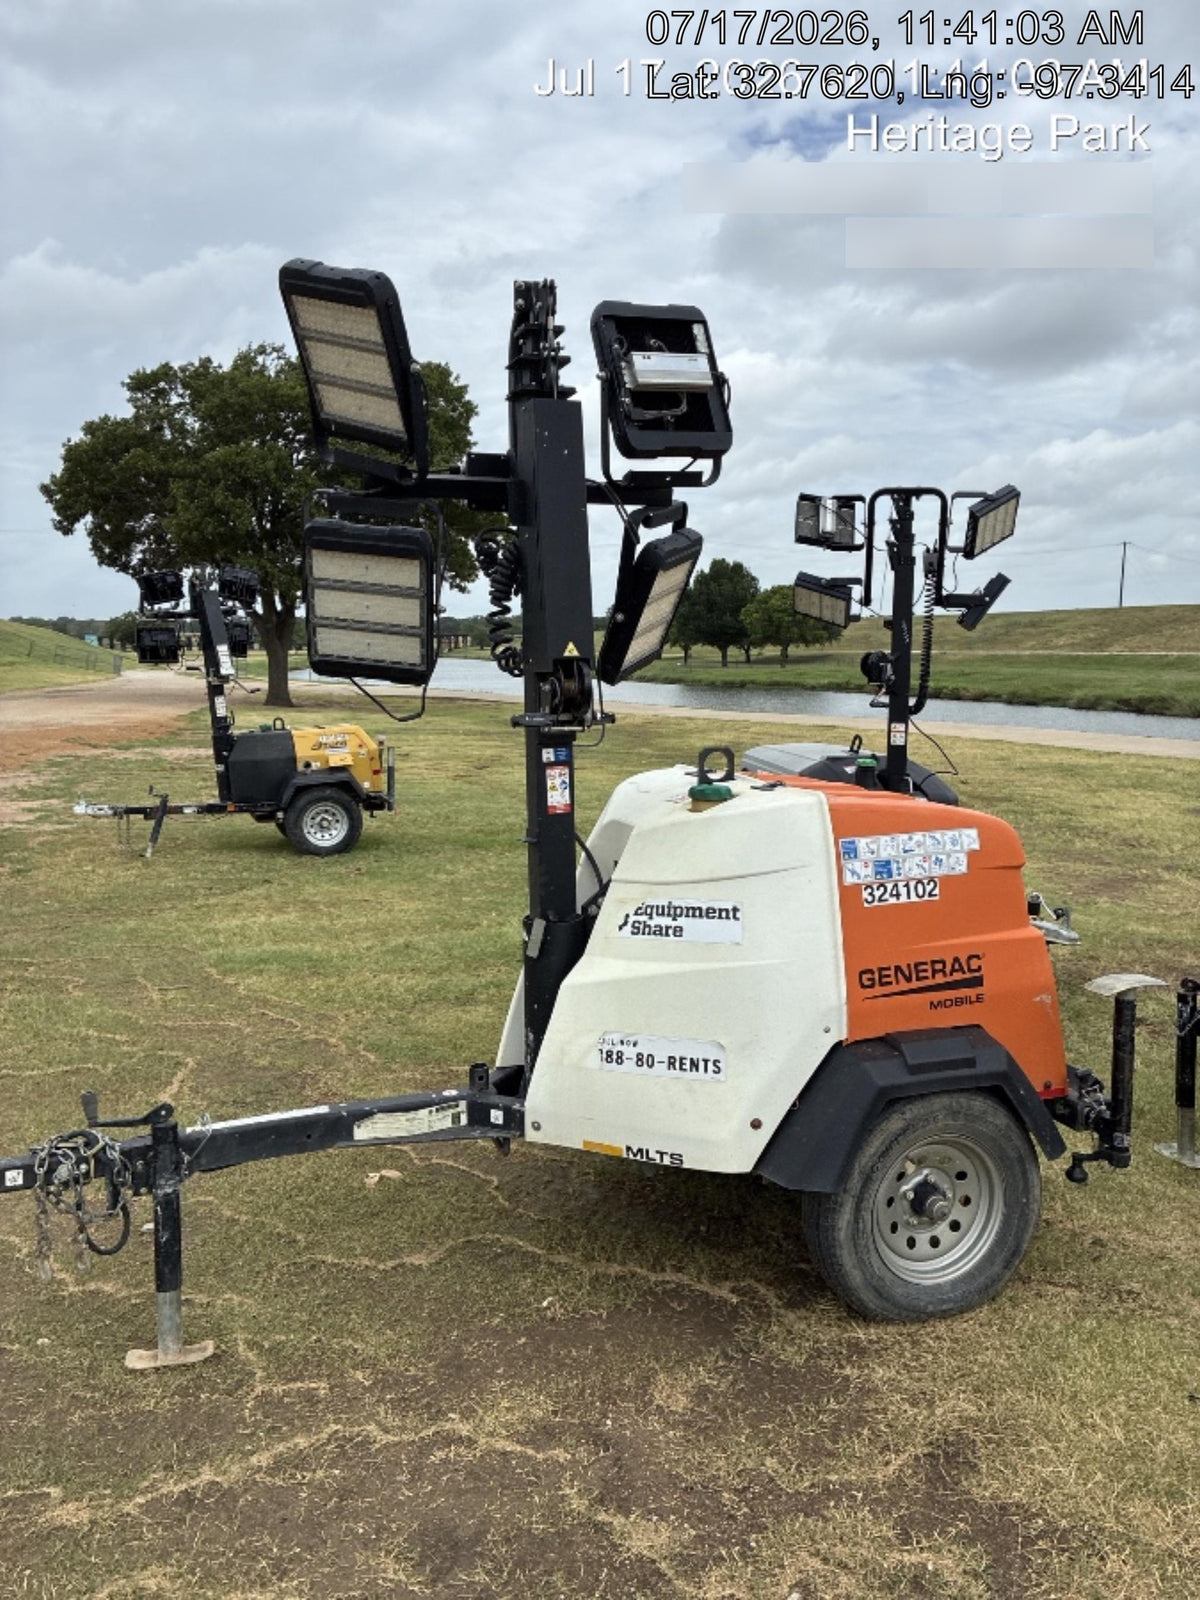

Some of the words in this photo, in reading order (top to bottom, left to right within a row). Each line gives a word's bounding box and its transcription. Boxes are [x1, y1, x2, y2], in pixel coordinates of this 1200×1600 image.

[863, 879, 938, 904] 324102
[630, 920, 684, 937] Share
[858, 954, 983, 989] GENERAC
[929, 993, 984, 1010] MOBILE
[625, 1145, 684, 1166] MLTS
